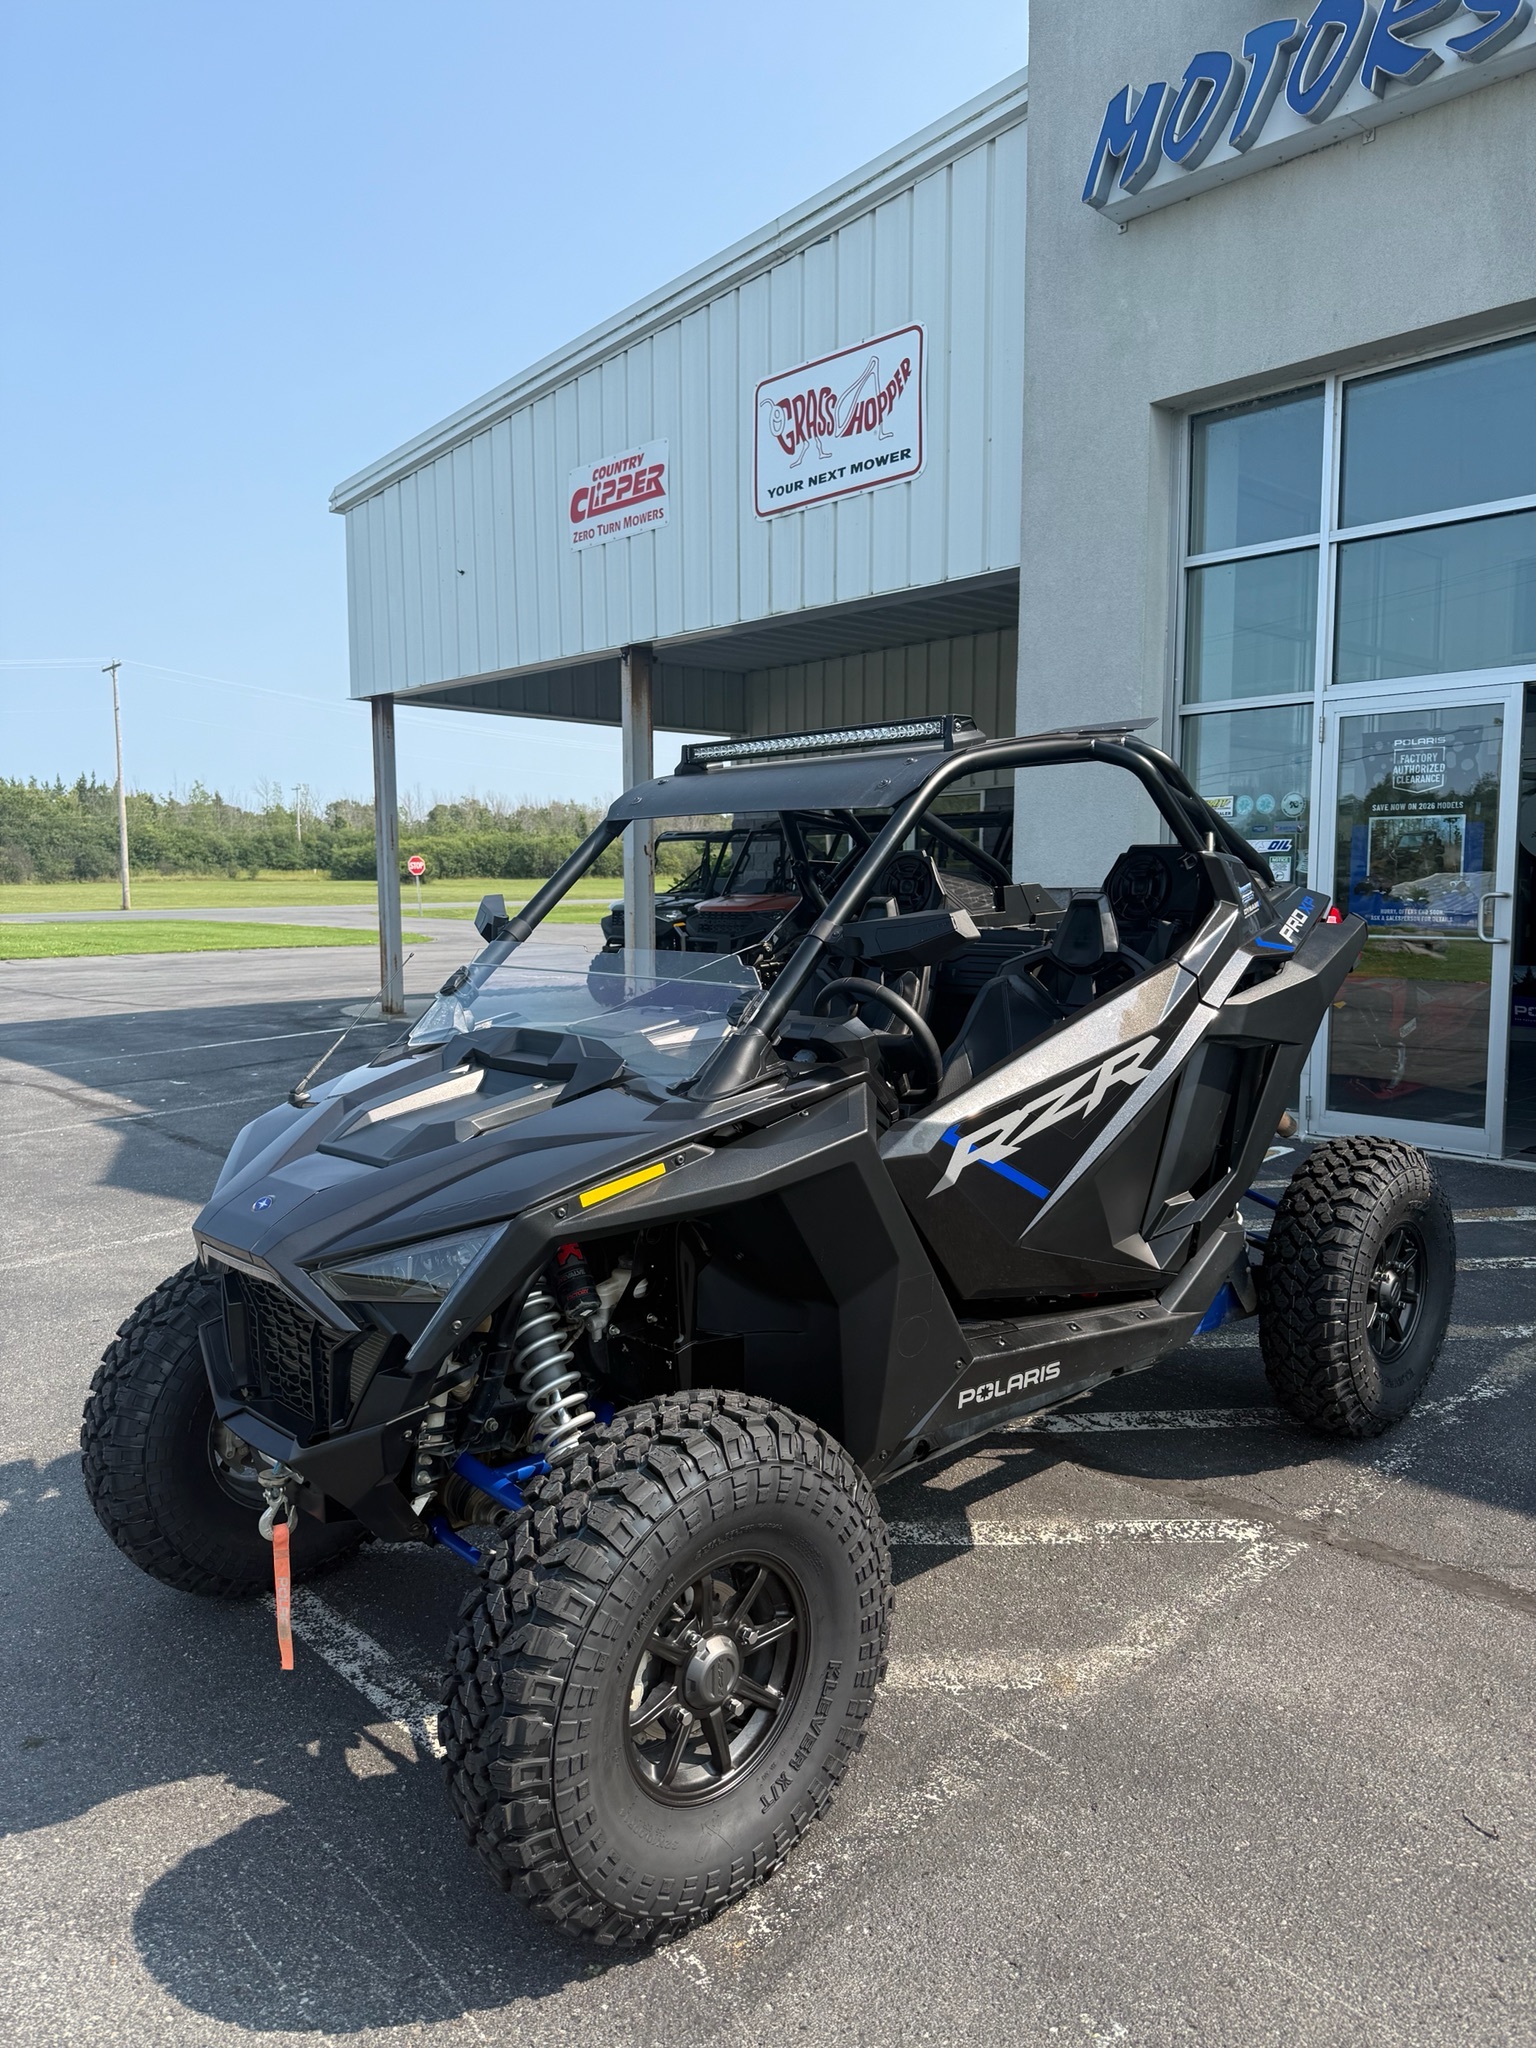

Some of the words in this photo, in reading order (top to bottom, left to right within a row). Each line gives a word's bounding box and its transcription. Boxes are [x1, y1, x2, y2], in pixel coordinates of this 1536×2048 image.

[592, 453, 645, 482] COUNTRY
[767, 479, 804, 498] YOUR
[808, 466, 847, 487] NEXT
[850, 447, 912, 475] MOWER
[570, 463, 667, 523] CLIPPER
[573, 528, 595, 544] ZERO
[597, 520, 621, 536] TURN
[623, 508, 664, 529] MOWERS
[1394, 736, 1446, 747] POLARIS
[1393, 763, 1446, 775] AUTHORIZED
[1400, 752, 1438, 764] FACTORY
[1396, 773, 1441, 785] CLEARANCE
[1372, 803, 1389, 812] SAVE
[1390, 803, 1406, 811] NOW
[1407, 802, 1417, 810] ON
[1437, 801, 1464, 810] MODELS
[409, 861, 424, 870] STOP
[926, 1035, 1160, 1199] RZR
[957, 1361, 1061, 1409] POLARIS
[789, 1660, 843, 1772] KLEVER
[760, 1770, 794, 1815] X/T
